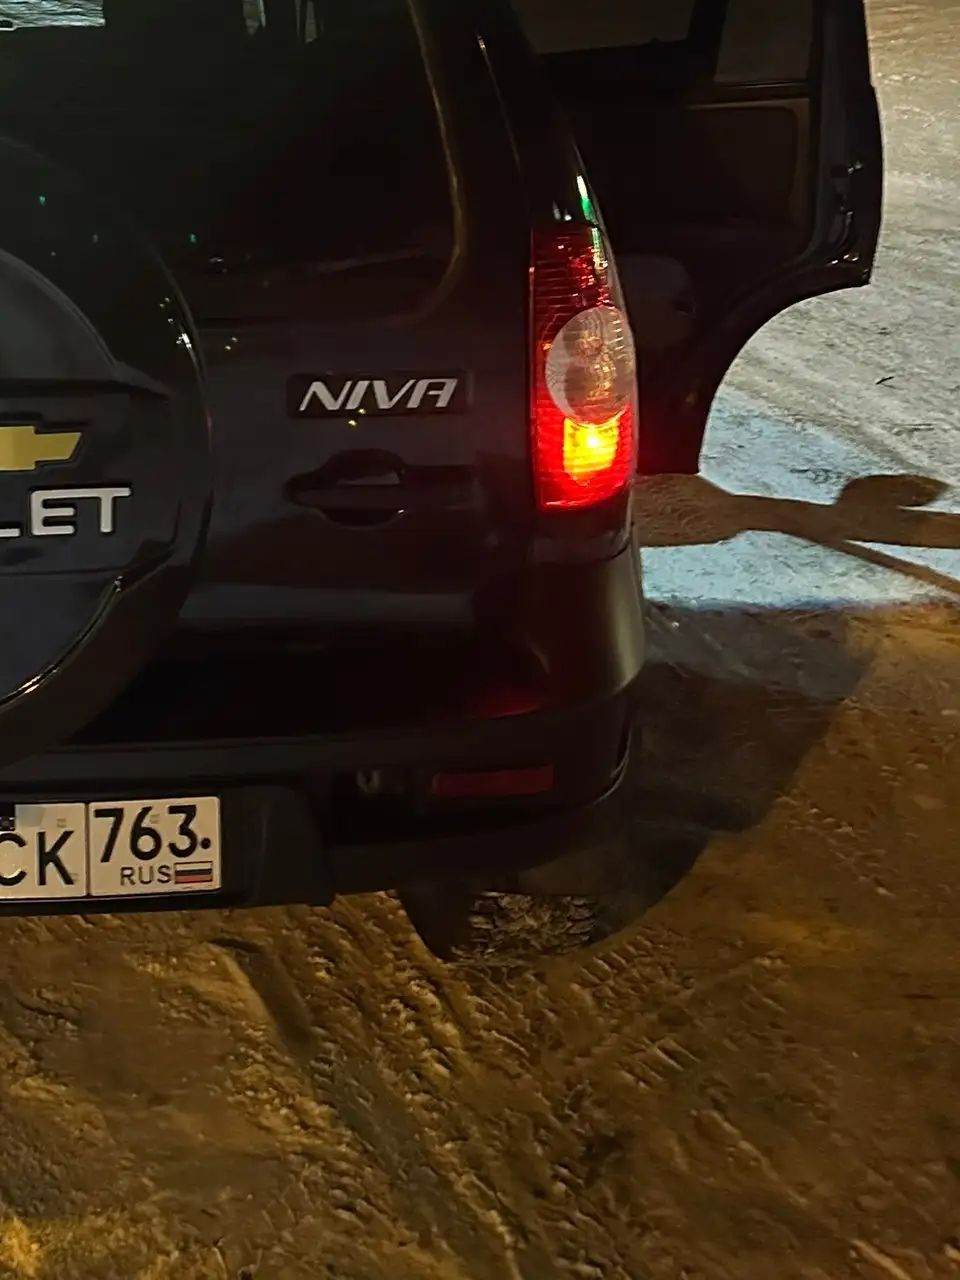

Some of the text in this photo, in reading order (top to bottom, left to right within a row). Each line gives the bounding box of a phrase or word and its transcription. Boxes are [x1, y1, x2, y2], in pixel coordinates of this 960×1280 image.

[299, 378, 458, 411] NIVA
[94, 805, 198, 862] 763
[120, 865, 172, 886] RUS
